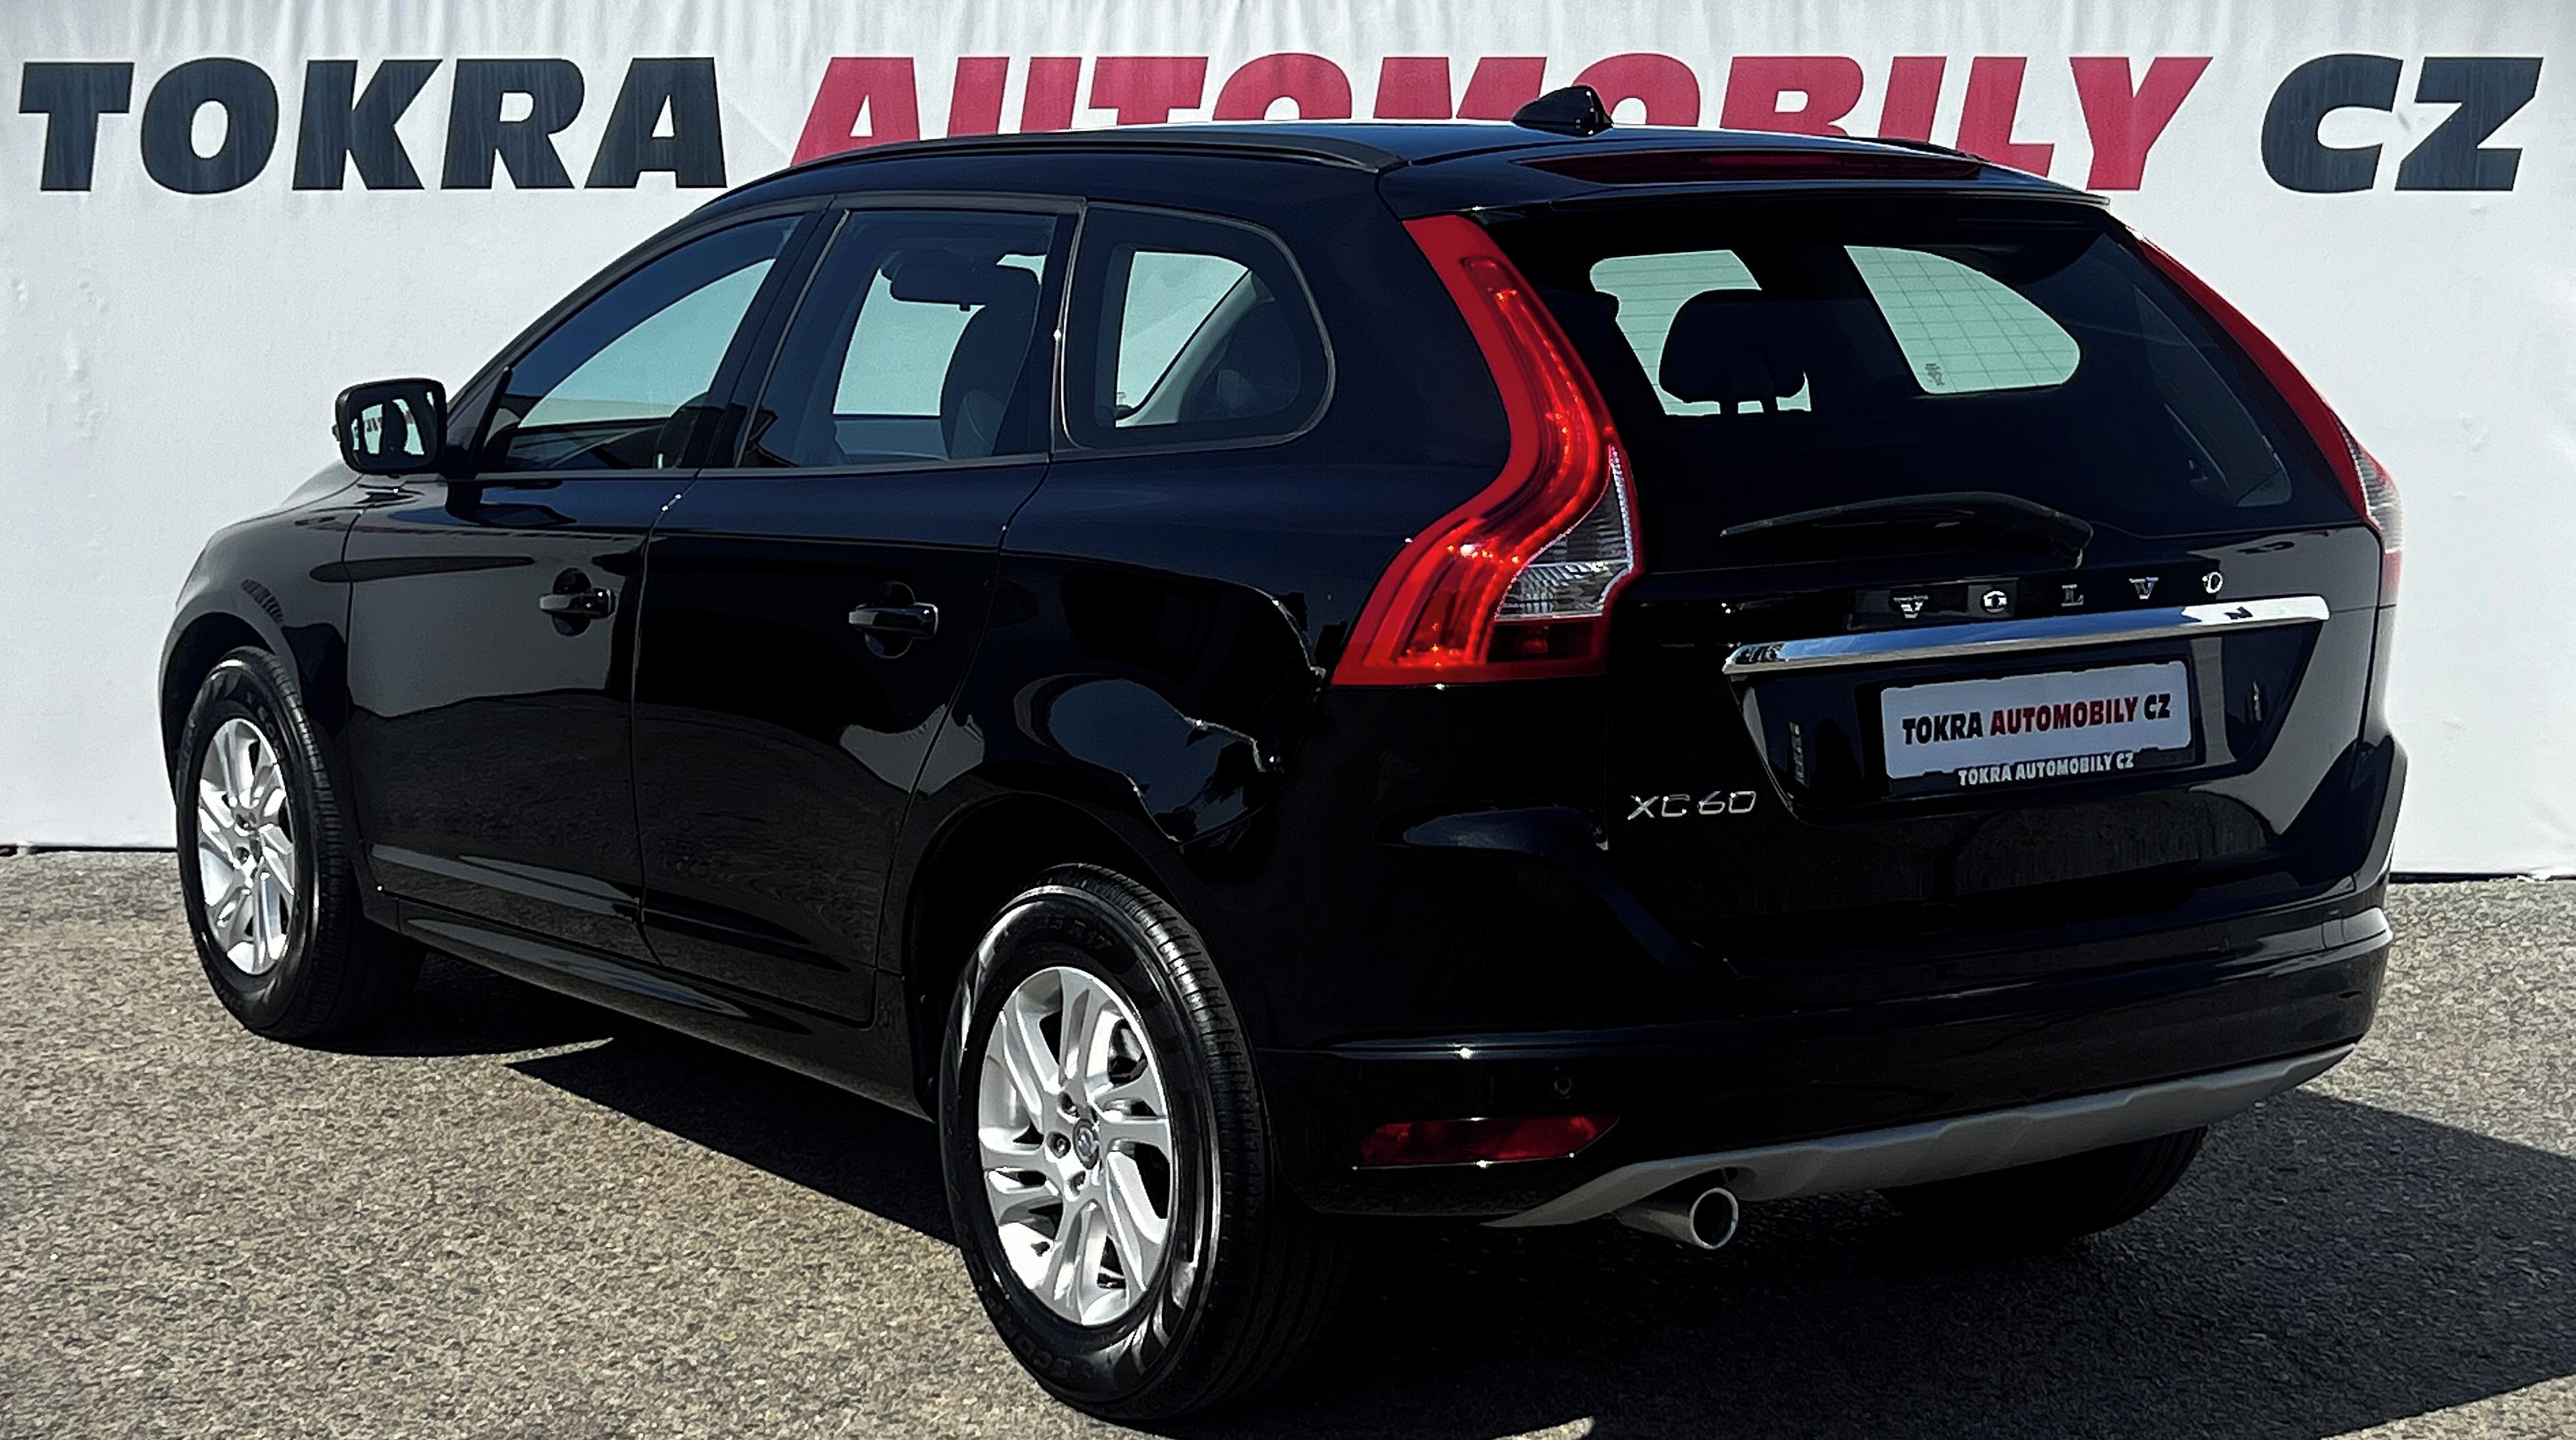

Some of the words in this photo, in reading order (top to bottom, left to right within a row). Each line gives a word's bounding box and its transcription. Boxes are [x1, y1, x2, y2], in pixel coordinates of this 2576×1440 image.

[18, 57, 728, 195] TOKRA
[2261, 53, 2544, 193] CZ
[1893, 571, 2225, 619] VOLVO
[1902, 711, 1983, 745] TOKRA
[1990, 696, 2138, 736] AUTOMOBILY
[2144, 693, 2171, 720] CZ
[1957, 764, 2012, 786] TOKRA
[2015, 754, 2112, 781] AUTOMOBILY
[2117, 752, 2134, 769] CZ
[1627, 790, 1756, 820] XC60
